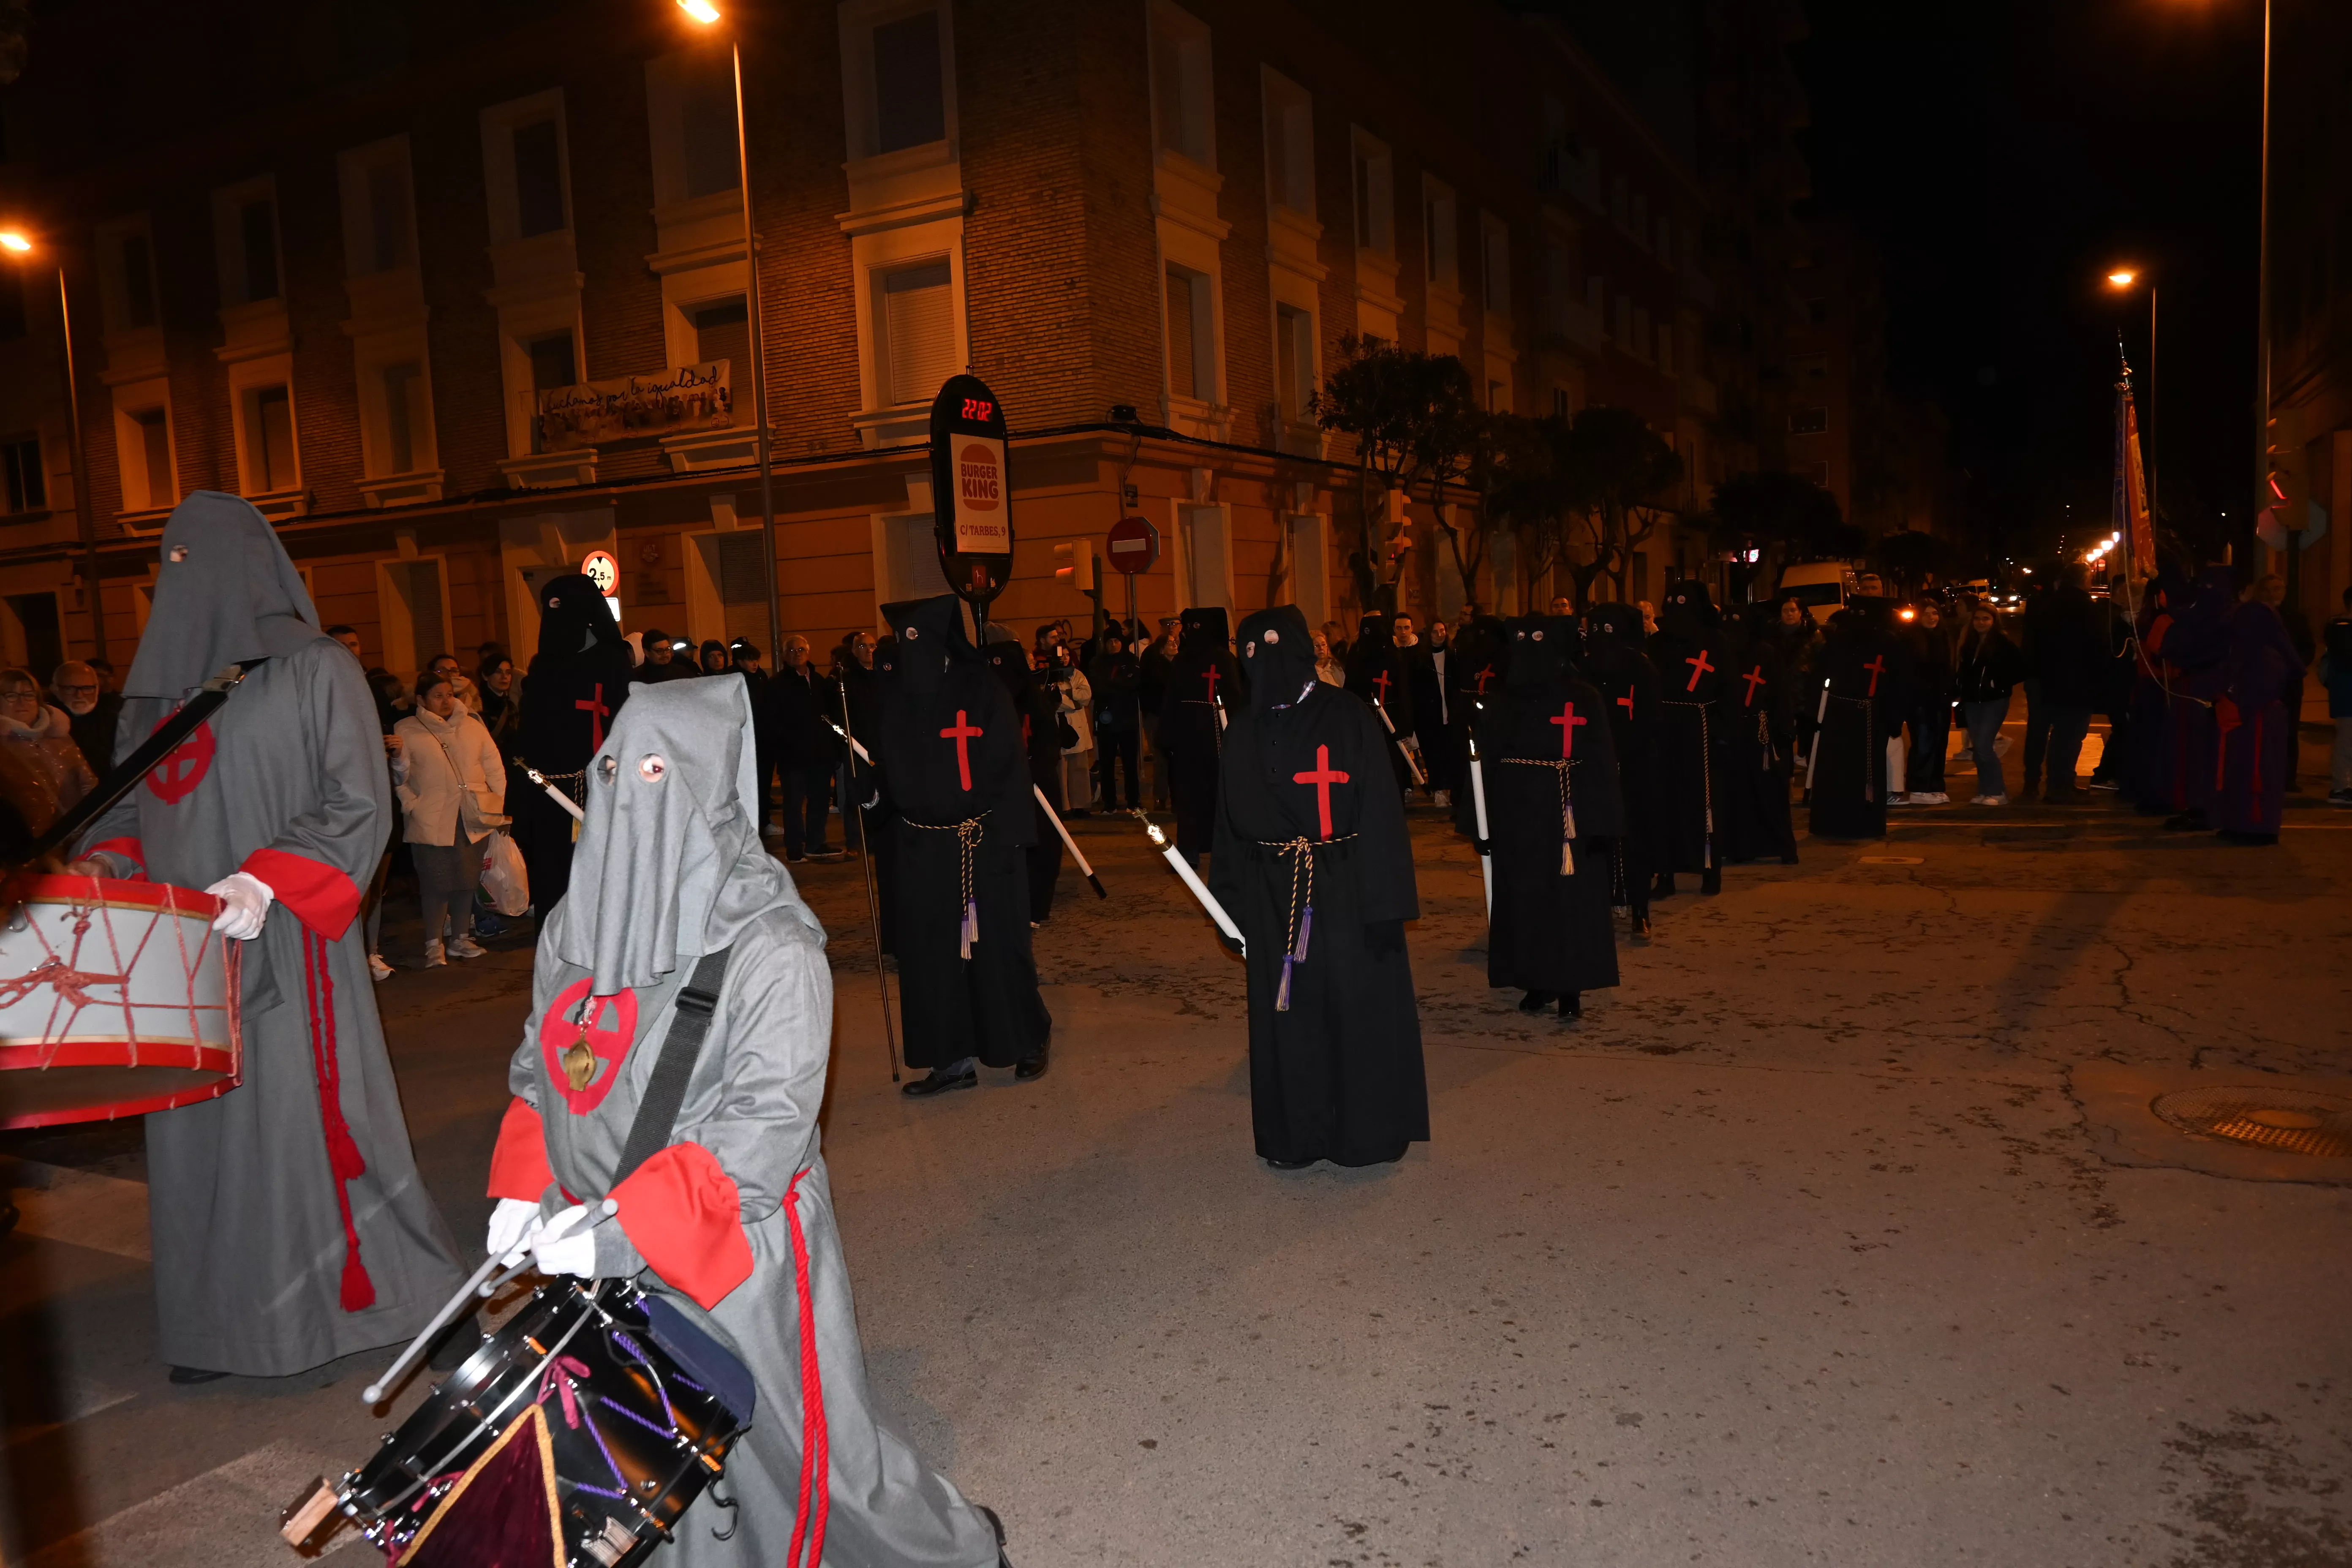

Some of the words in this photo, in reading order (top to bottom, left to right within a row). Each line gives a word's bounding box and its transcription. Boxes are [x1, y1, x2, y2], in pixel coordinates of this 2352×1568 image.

[607, 391, 628, 413] por
[631, 376, 645, 395] la
[648, 366, 719, 406] igualdad
[961, 463, 998, 479] BURGER
[962, 478, 999, 499] KING
[960, 524, 968, 536] C/
[969, 525, 1001, 538] TARBES,
[1001, 526, 1006, 536] 9
[589, 568, 605, 581] 2,5
